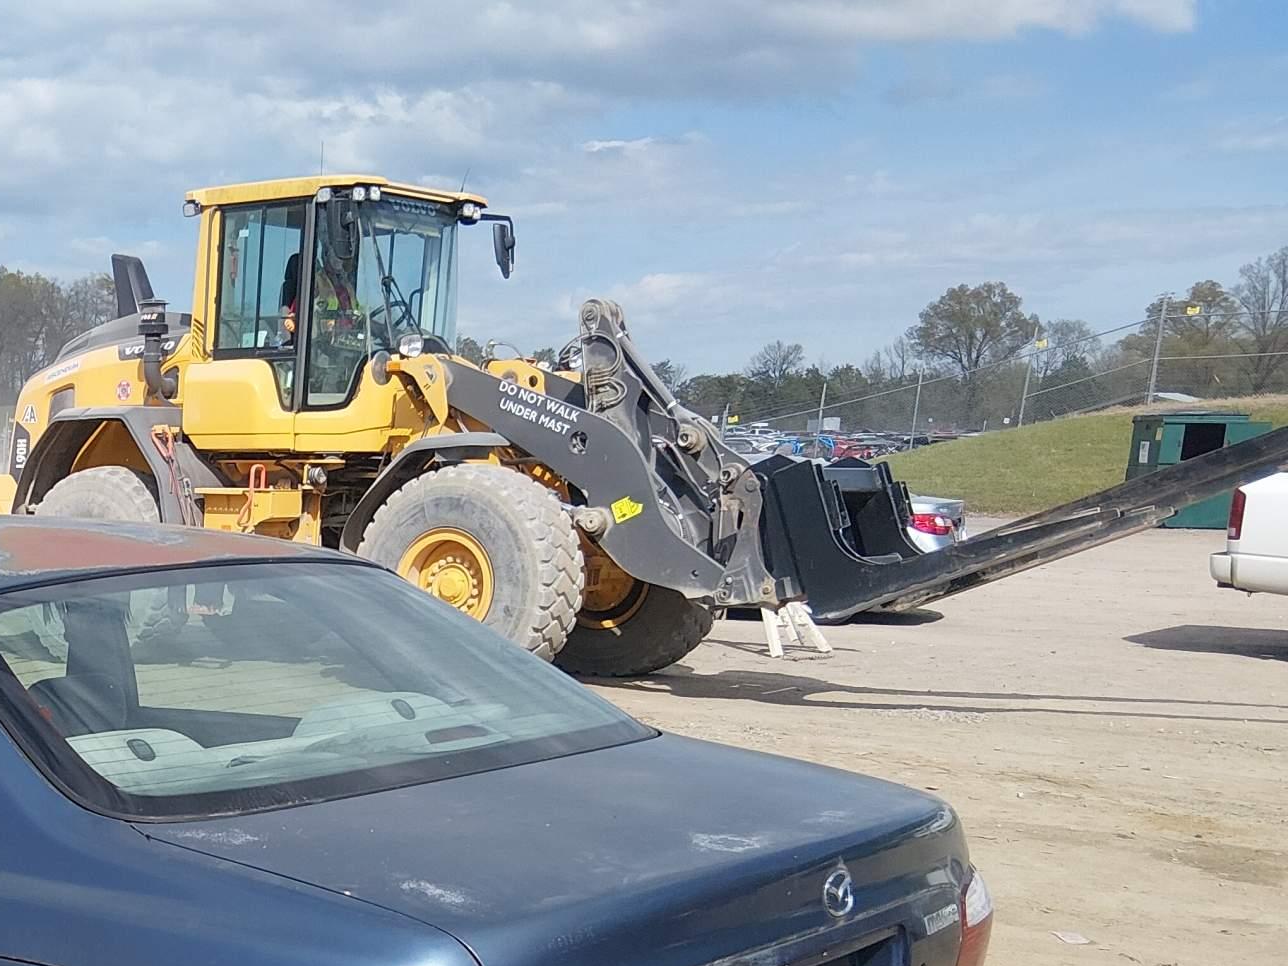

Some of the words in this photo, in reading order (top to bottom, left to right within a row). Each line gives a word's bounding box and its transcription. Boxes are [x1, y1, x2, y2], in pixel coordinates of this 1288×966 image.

[124, 340, 176, 356] VOO
[499, 381, 517, 396] DO
[518, 389, 545, 407] NOT
[546, 399, 580, 423] WALK
[499, 397, 537, 423] UNDER
[538, 414, 571, 435] MAST
